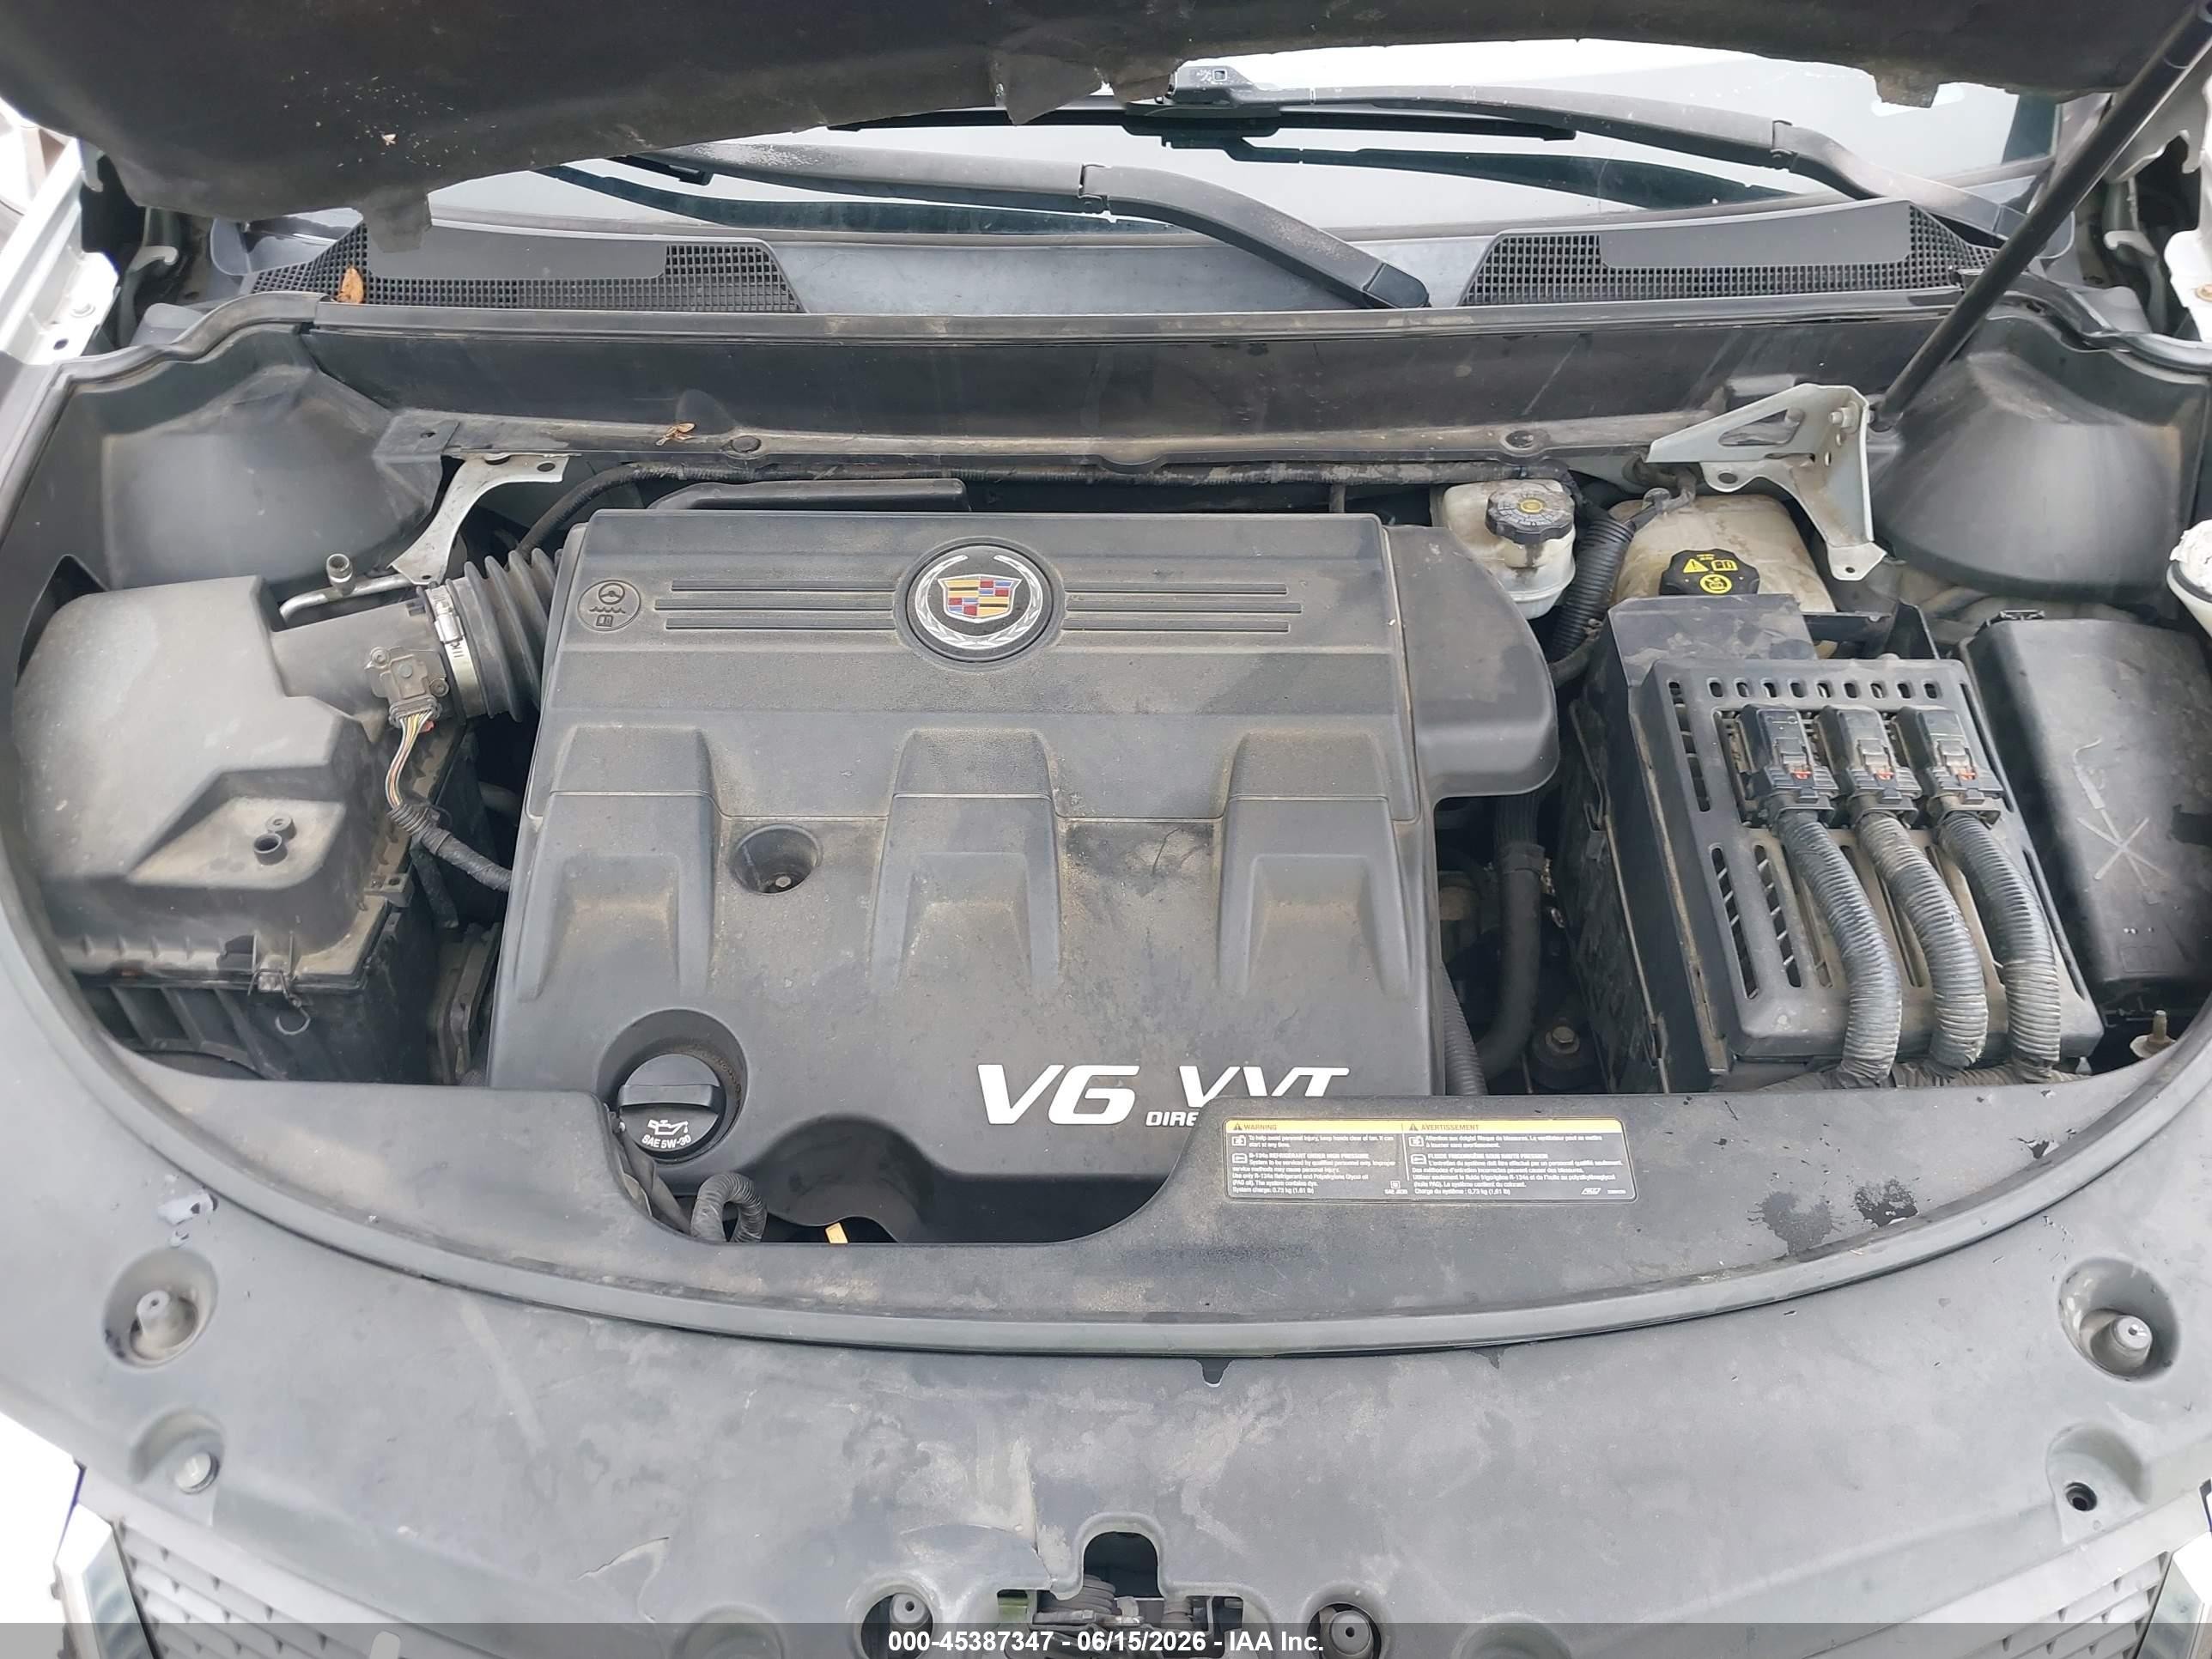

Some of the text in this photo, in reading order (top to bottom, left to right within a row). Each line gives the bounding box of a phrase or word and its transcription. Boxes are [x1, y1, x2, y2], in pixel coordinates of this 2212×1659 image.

[977, 1064, 1350, 1125] V6 VVT
[641, 1134, 691, 1148] SAE 5W-30
